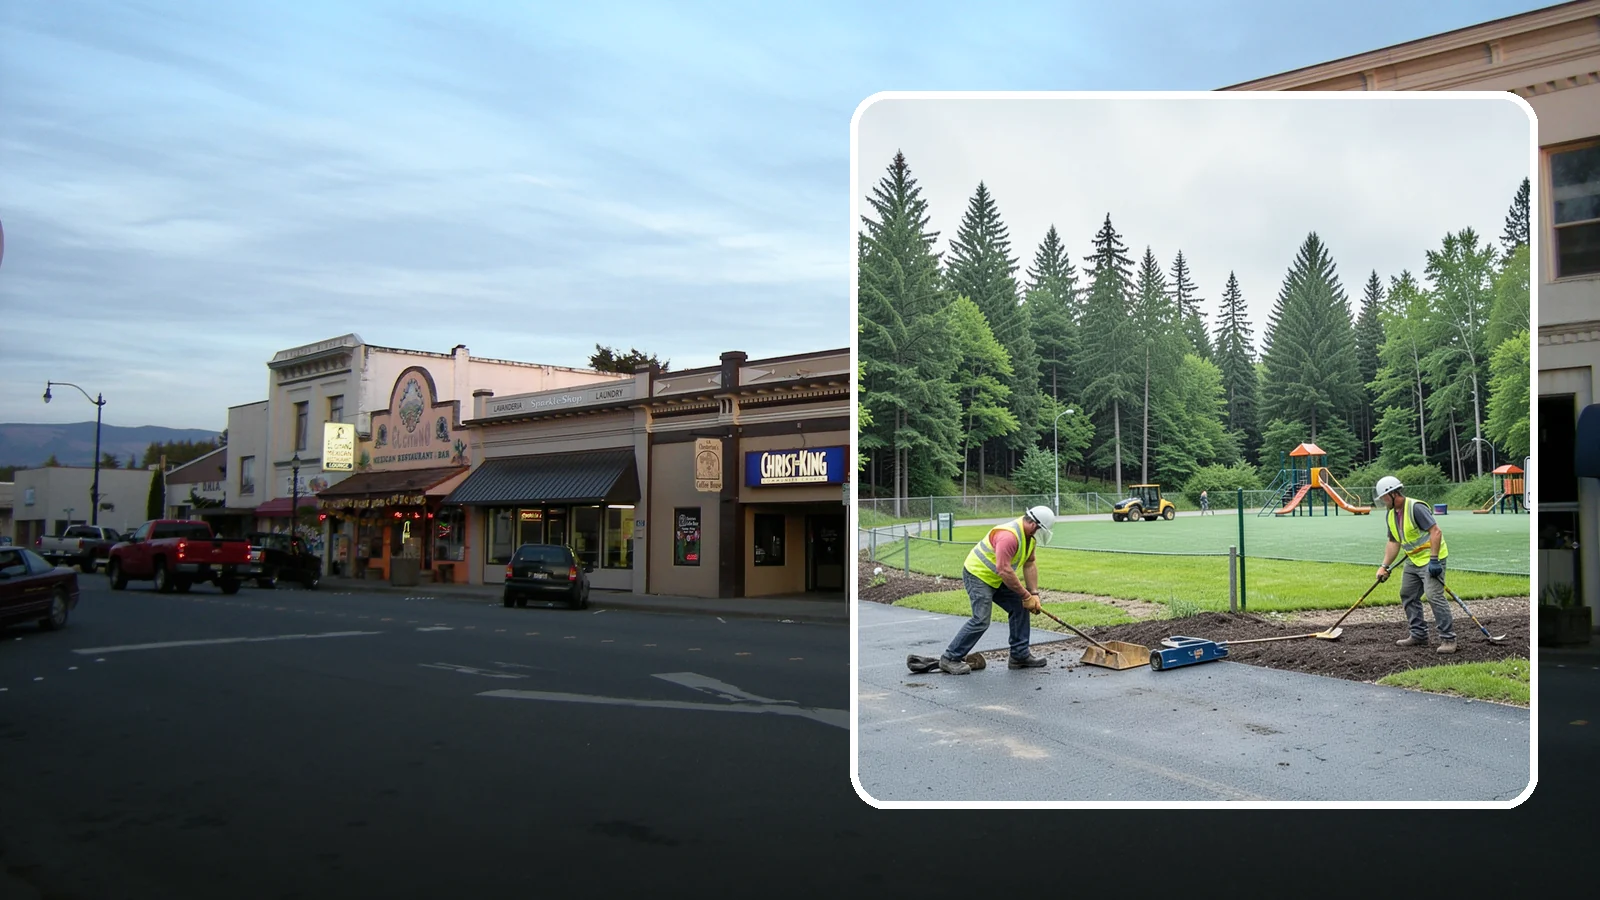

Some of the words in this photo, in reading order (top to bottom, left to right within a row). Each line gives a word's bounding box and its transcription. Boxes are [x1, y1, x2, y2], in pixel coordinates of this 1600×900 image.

[531, 398, 562, 408] Sparkle
[563, 394, 582, 405] Shop
[596, 389, 623, 400] LAUNDRY
[494, 402, 522, 412] LAVANDERIA
[374, 456, 396, 464] MEXICAN
[397, 451, 433, 462] RESTAURANT
[437, 450, 450, 459] BAR
[800, 450, 827, 476] KING
